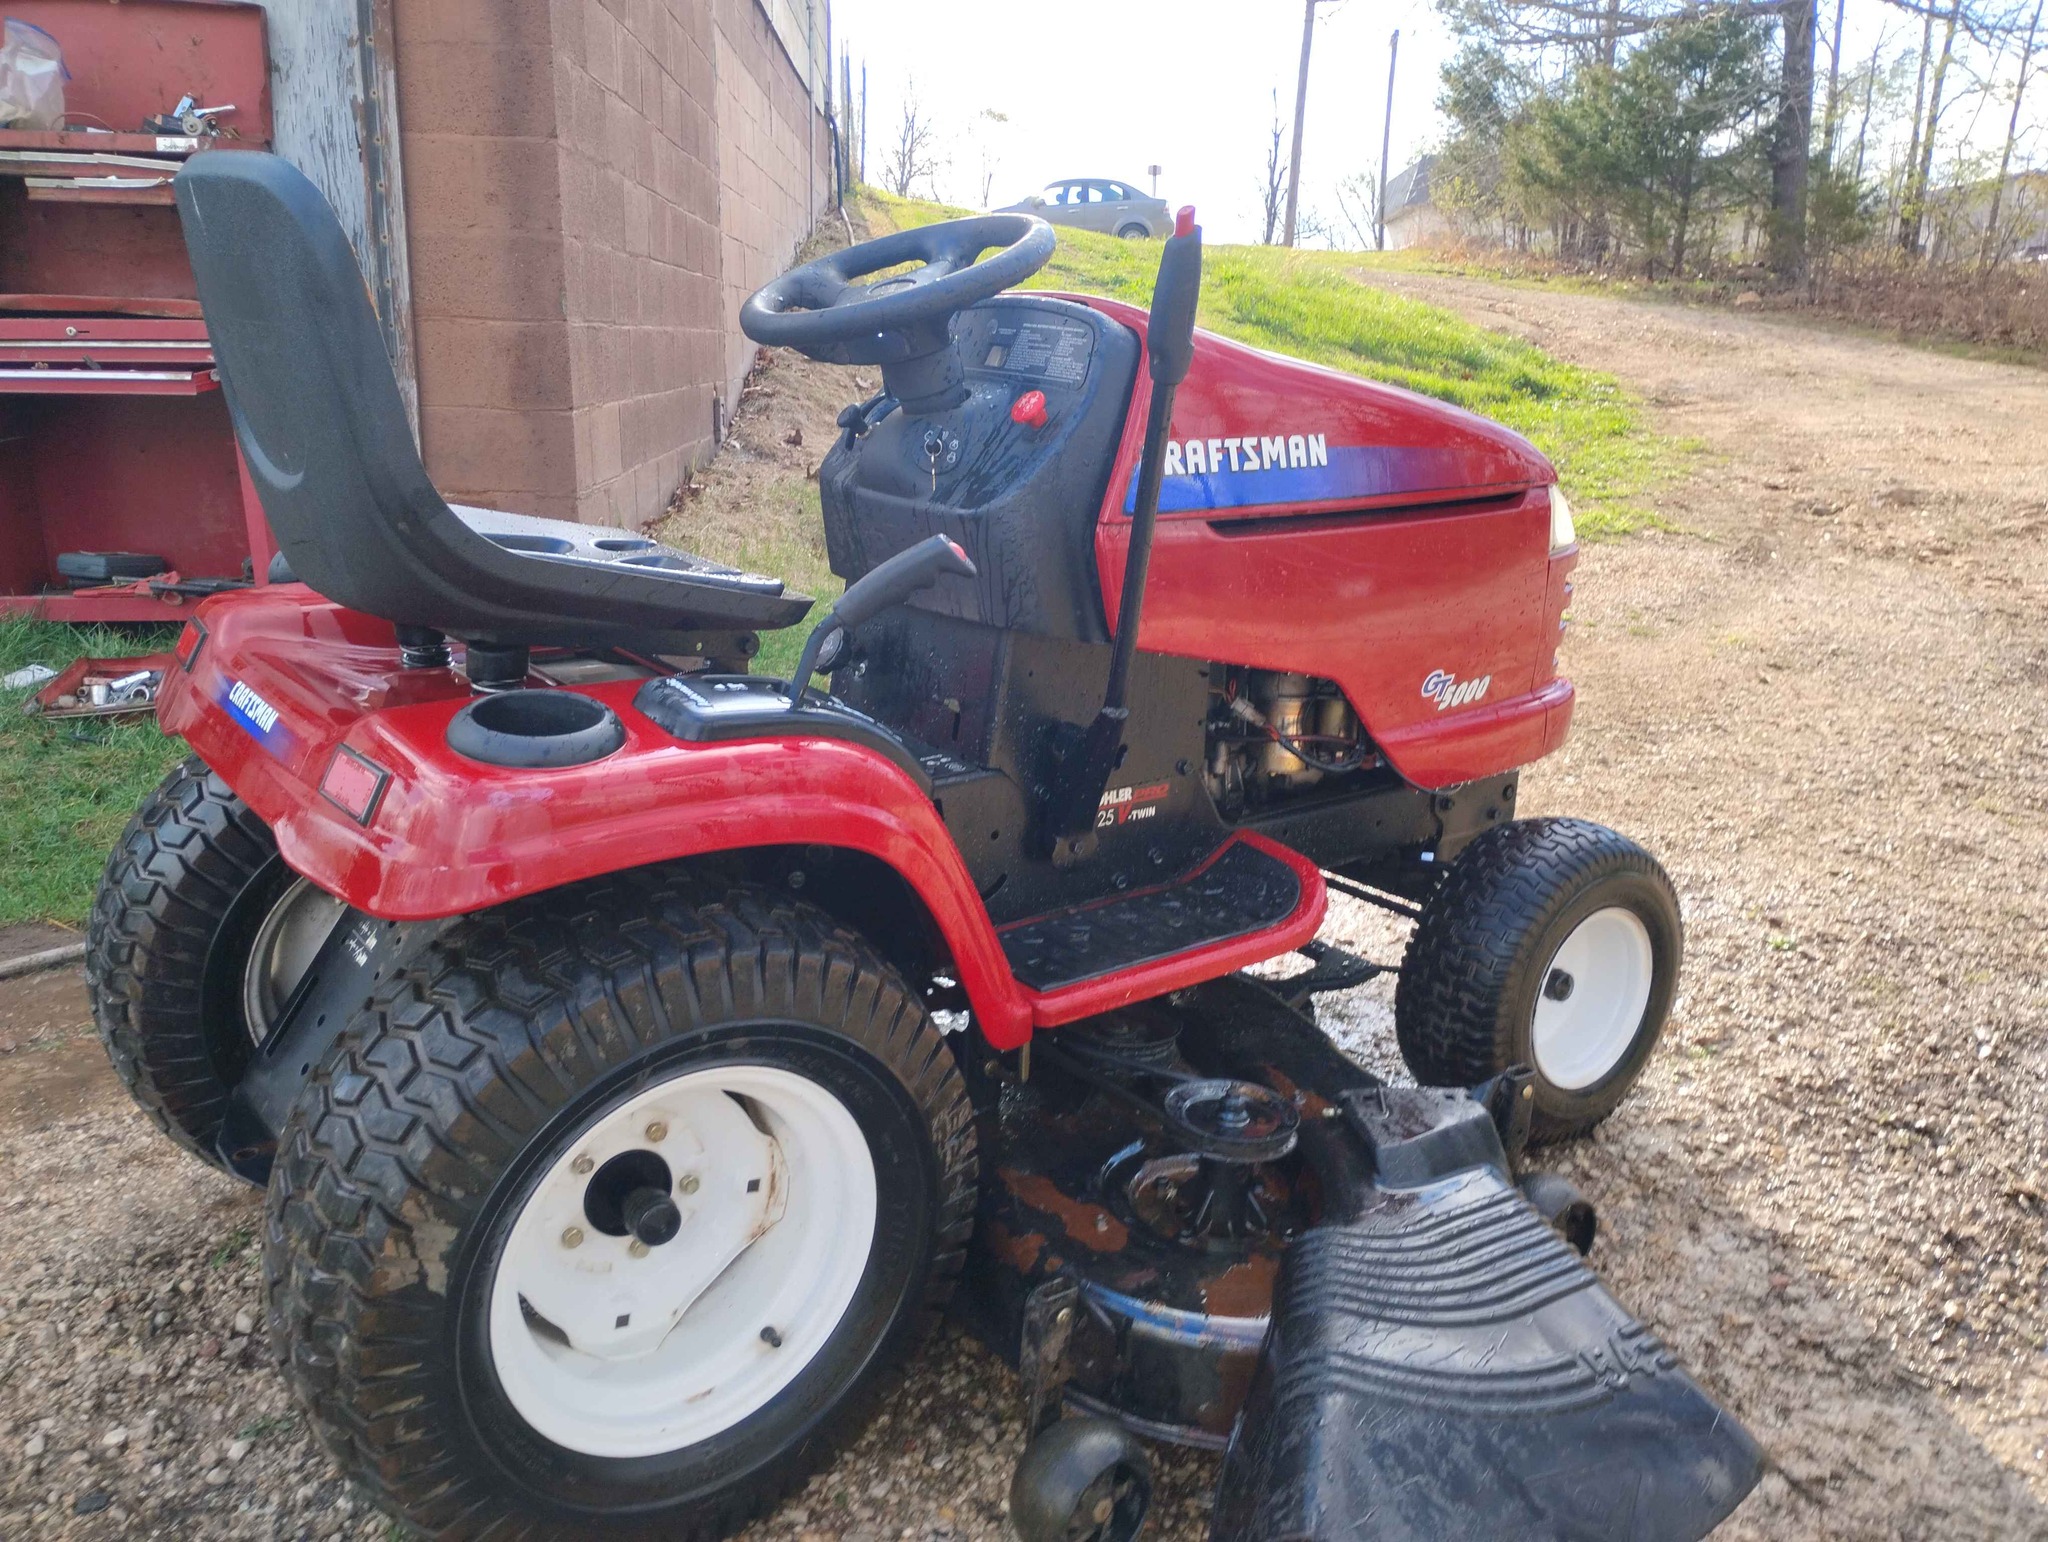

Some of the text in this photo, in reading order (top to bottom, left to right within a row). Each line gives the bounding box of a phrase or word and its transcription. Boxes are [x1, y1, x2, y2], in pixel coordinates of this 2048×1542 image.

[1163, 433, 1328, 476] RAFTSMAN
[229, 680, 279, 733] CRAFTSMAN
[1097, 809, 1115, 828] 25
